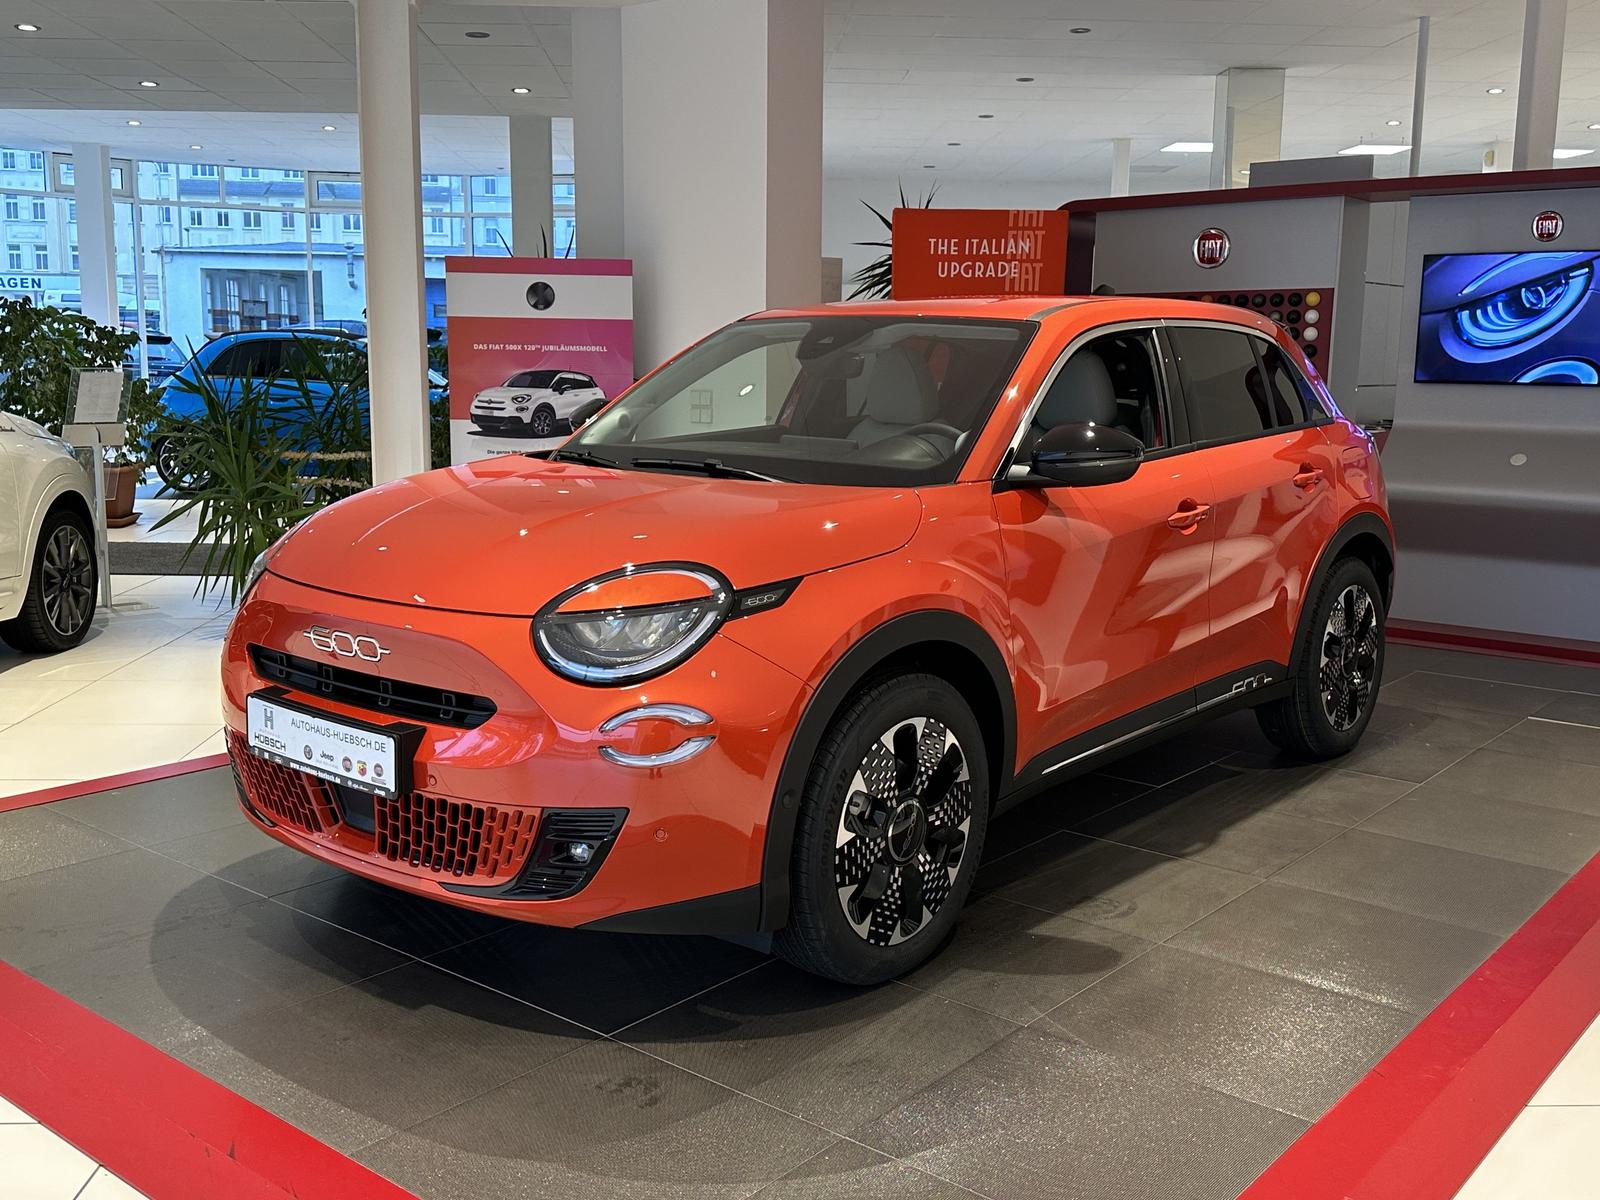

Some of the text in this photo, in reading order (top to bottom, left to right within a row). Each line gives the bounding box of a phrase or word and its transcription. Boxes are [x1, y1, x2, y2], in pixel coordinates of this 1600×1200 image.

[1538, 220, 1557, 234] FIAT
[929, 238, 1031, 255] THE ITALIAN
[1200, 240, 1222, 258] FIAT
[938, 261, 1019, 278] UPGRADE
[541, 343, 608, 352] JUBILÄUMSMODELL
[745, 593, 777, 606] 600
[303, 625, 391, 662] 600
[320, 750, 335, 762] Jeep
